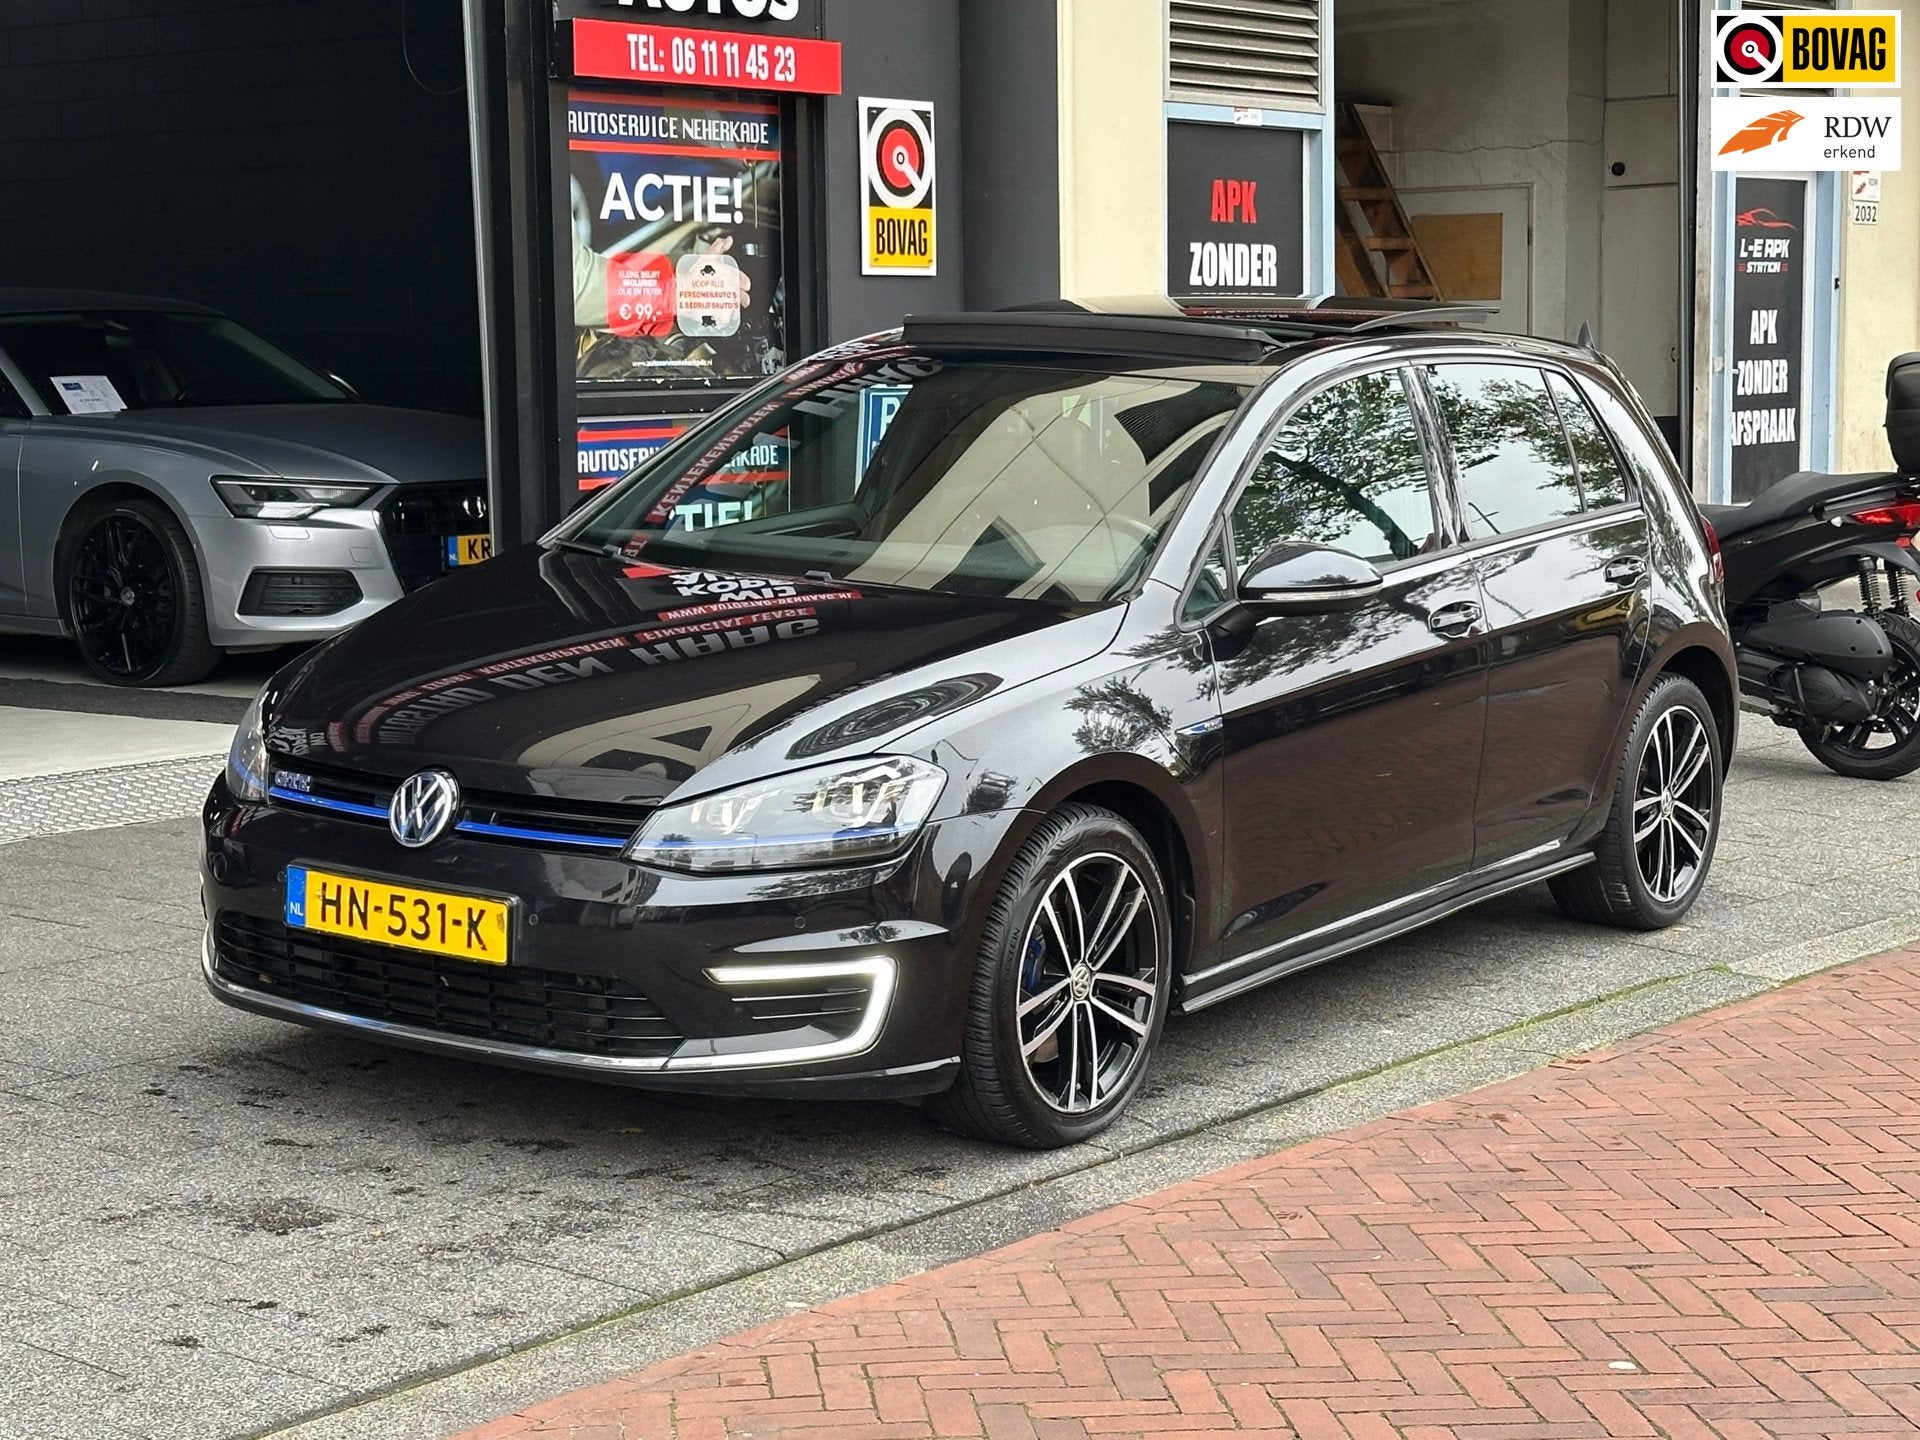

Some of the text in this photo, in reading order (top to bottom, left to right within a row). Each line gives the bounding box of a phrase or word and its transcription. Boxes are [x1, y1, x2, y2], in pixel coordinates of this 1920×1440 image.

[626, 32, 796, 83] TEL: 06 11 11 45 23
[568, 110, 769, 144] AUTOSERVICE NEHERKADE
[600, 172, 744, 225] ACTIE!
[1210, 179, 1258, 224] APK
[1855, 205, 1877, 222] 2032
[876, 217, 928, 257] BOVAG
[1764, 238, 1790, 258] APK
[1189, 242, 1277, 287] ZONDER
[1750, 309, 1778, 345] APK
[1737, 359, 1788, 395] ZONDER
[289, 881, 488, 951] NL HN-531-K
